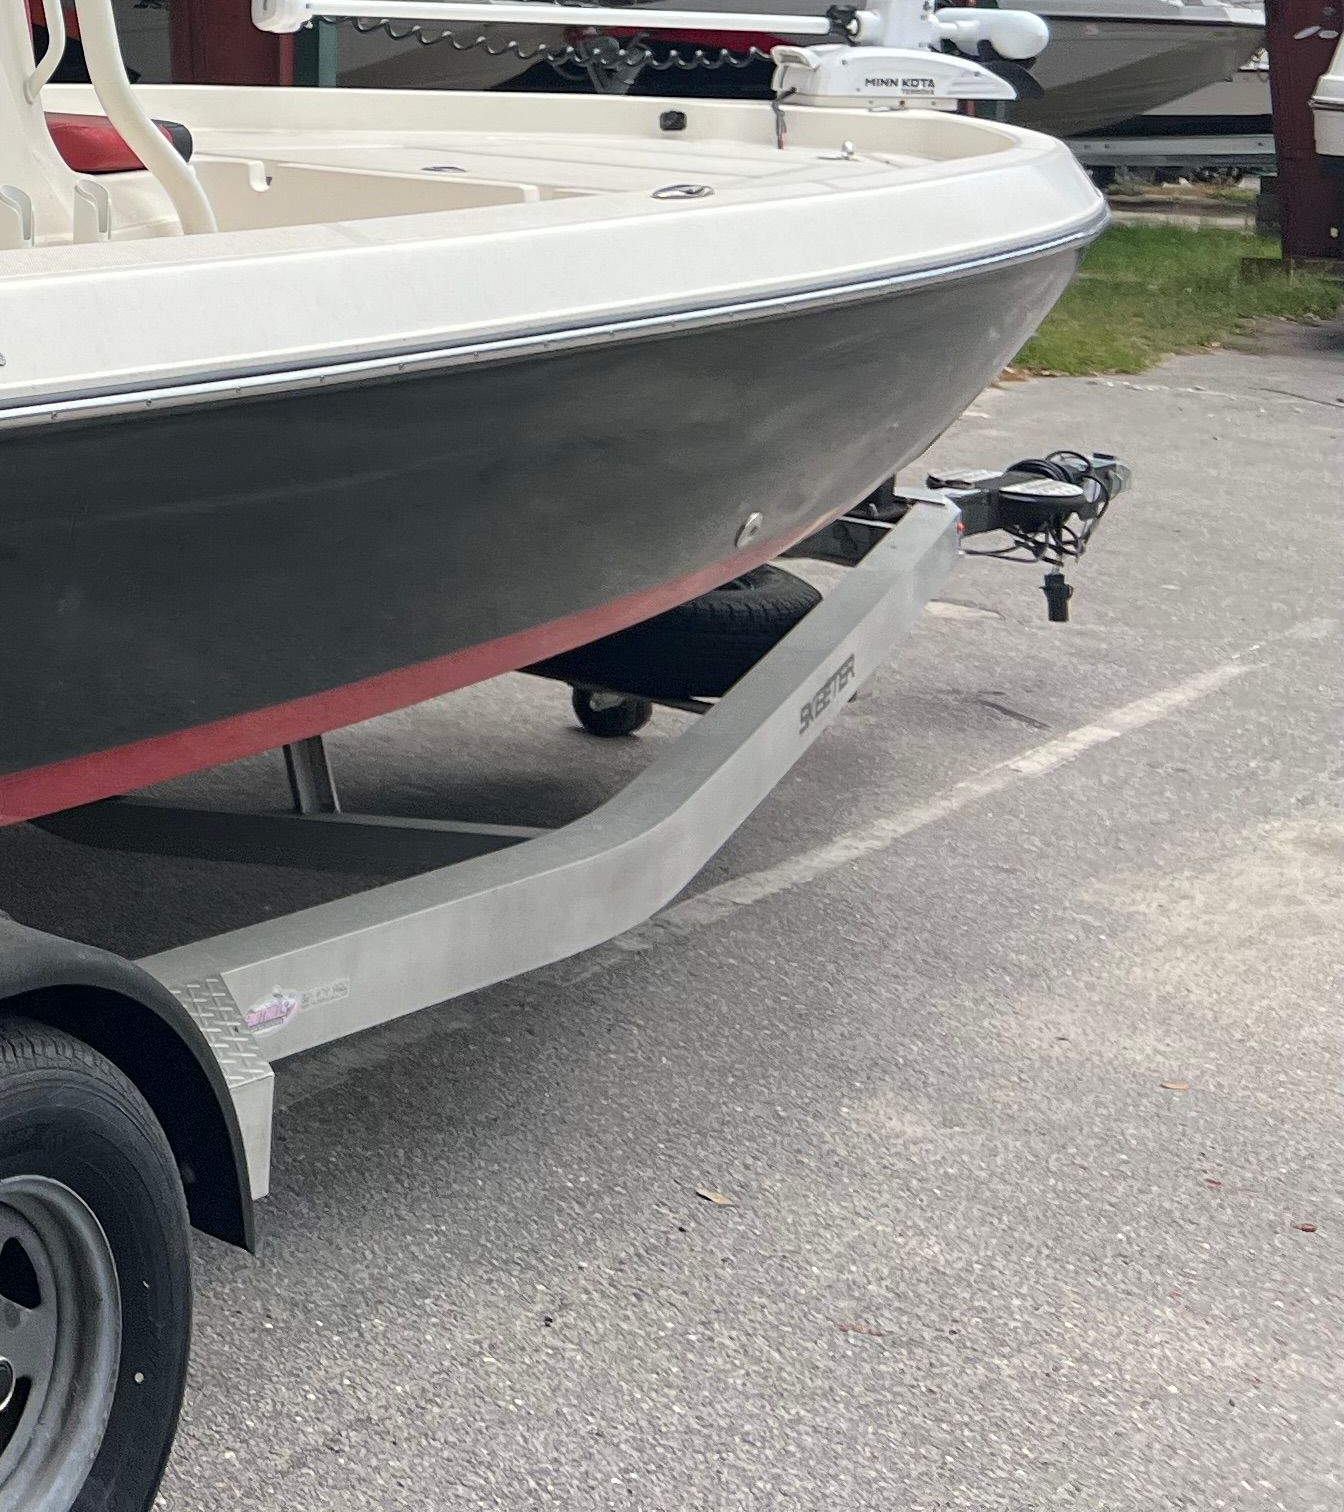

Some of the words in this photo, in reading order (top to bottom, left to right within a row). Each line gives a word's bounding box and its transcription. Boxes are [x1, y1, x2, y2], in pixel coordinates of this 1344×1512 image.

[865, 78, 899, 88] MINN
[901, 78, 935, 88] KOTA
[799, 653, 855, 735] SKEETER
